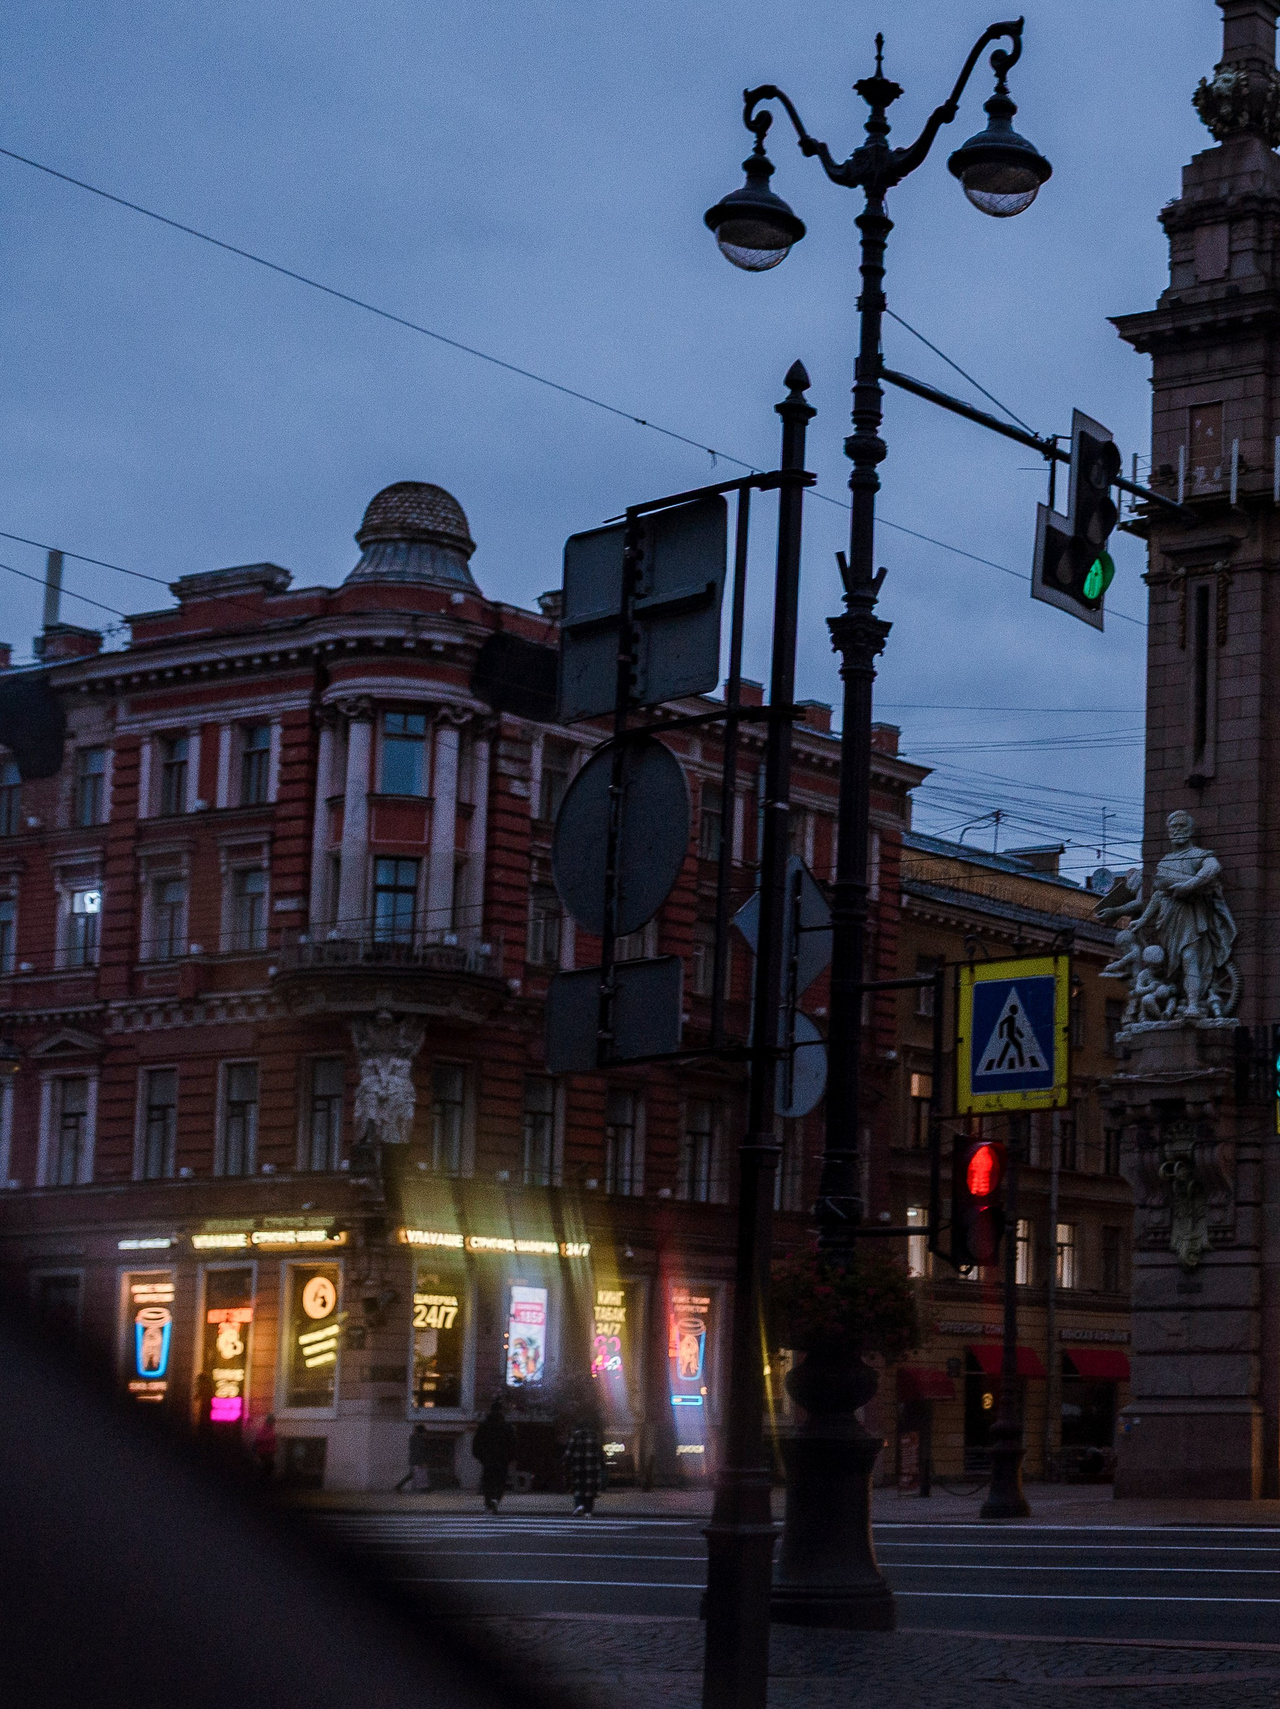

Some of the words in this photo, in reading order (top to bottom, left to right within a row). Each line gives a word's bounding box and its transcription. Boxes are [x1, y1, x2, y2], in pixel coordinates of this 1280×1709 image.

[565, 1242, 591, 1257] 24/7
[412, 1305, 459, 1329] 24/7
[595, 1322, 622, 1336] 24/7
